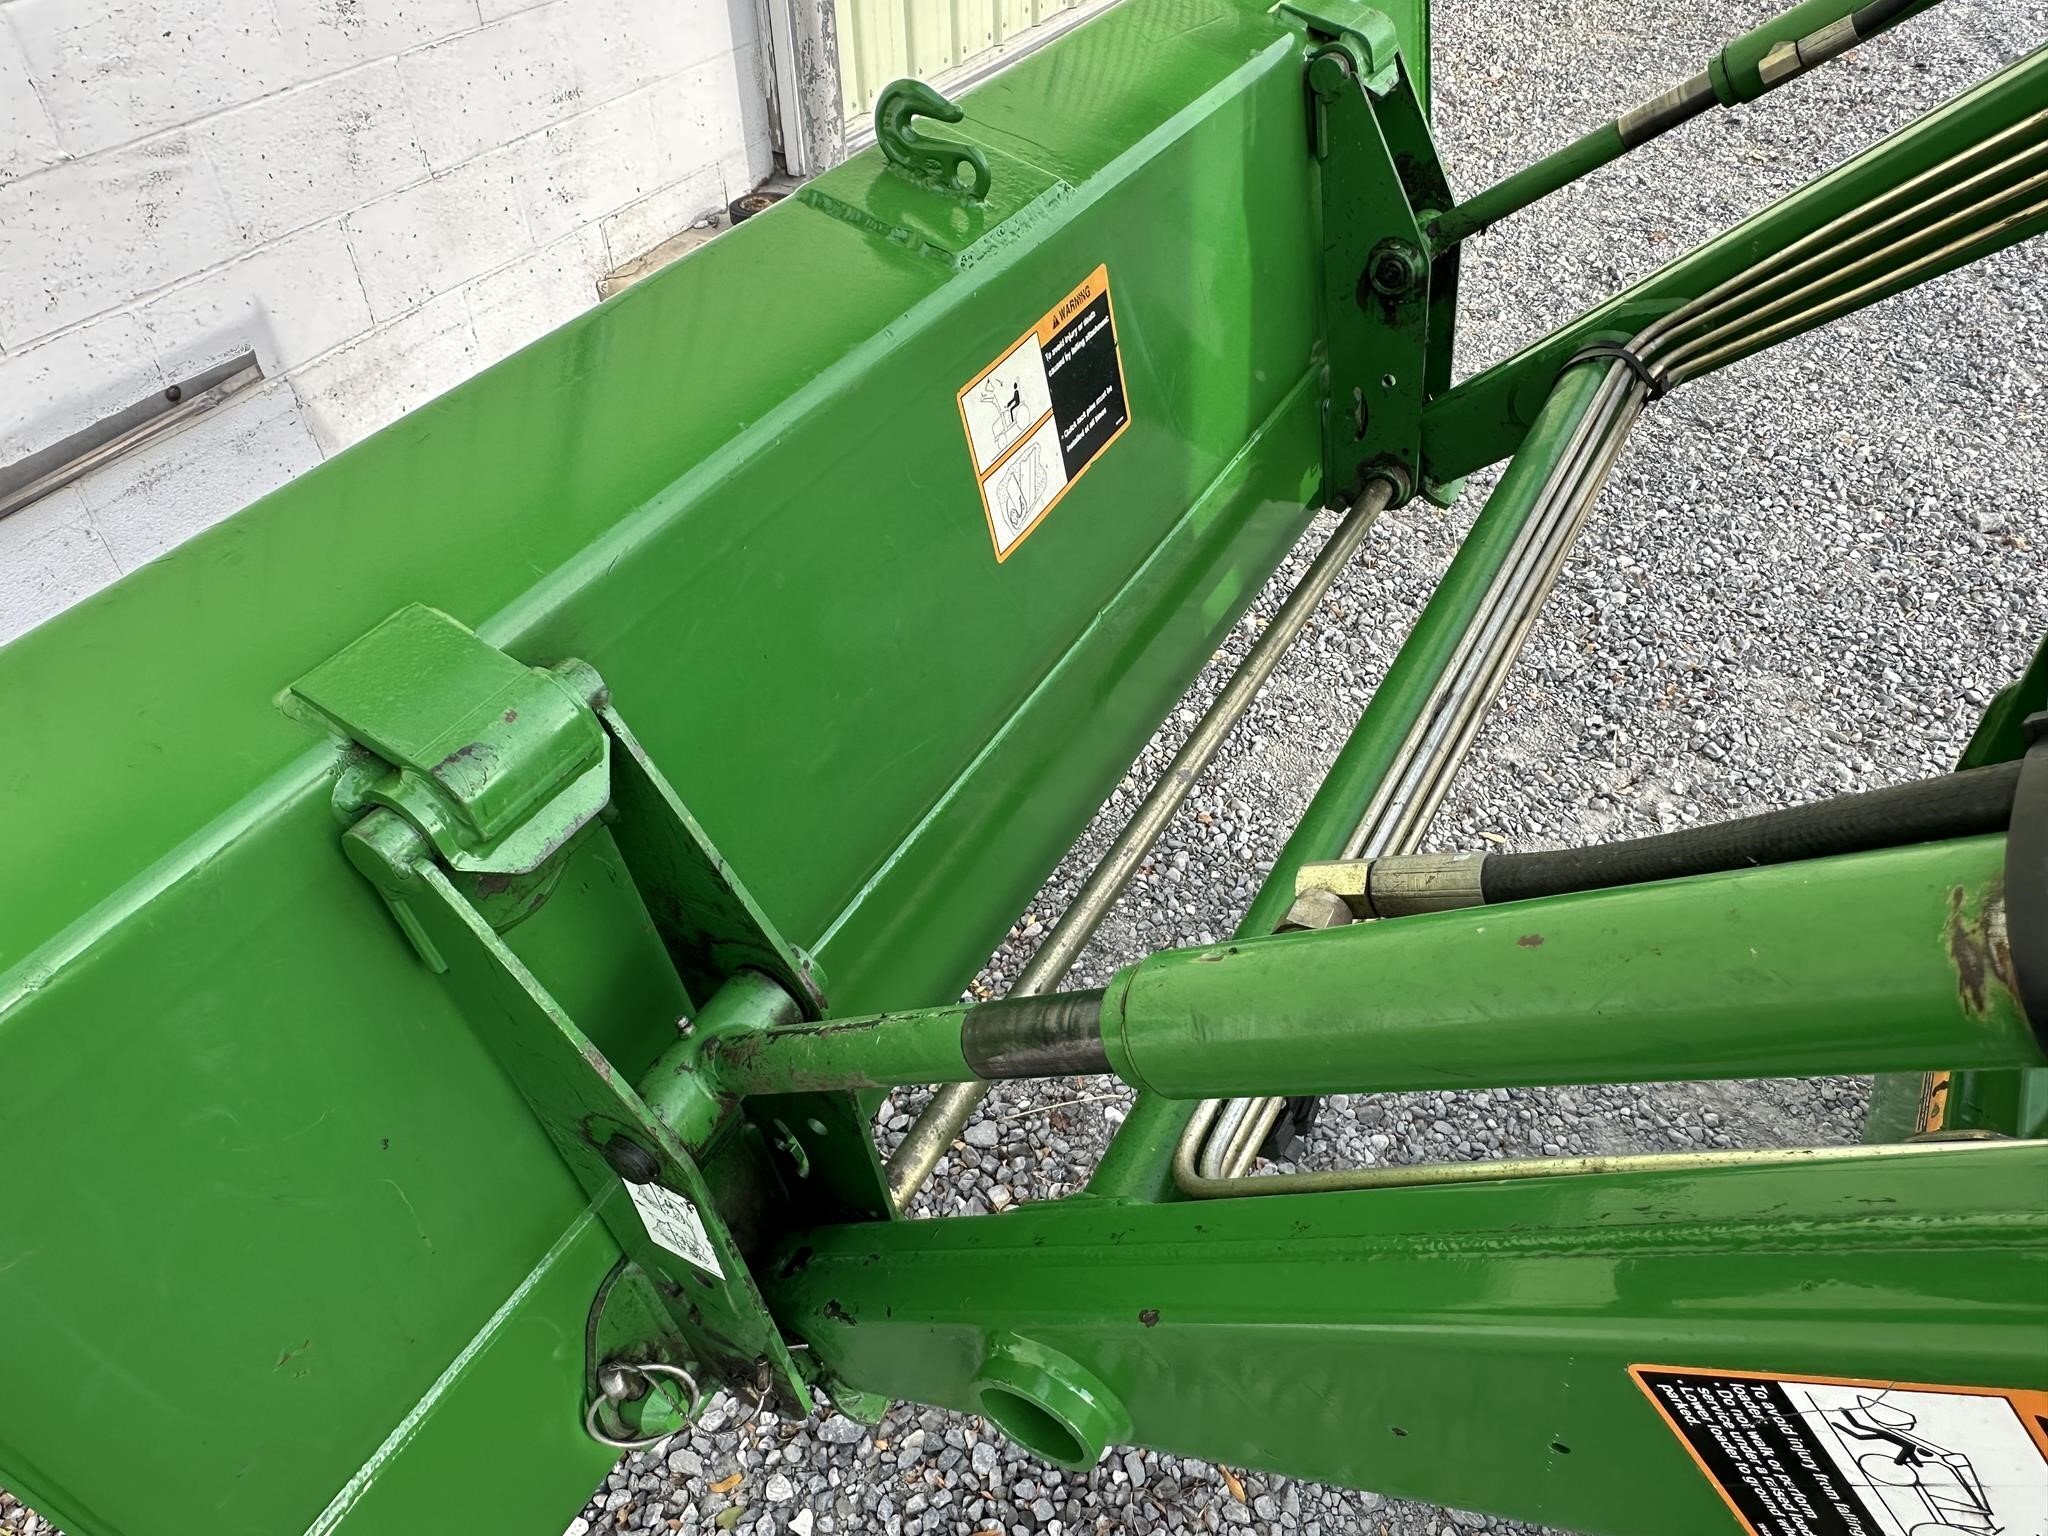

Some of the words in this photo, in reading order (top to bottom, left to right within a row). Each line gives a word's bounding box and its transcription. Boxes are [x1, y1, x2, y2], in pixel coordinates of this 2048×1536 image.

[1059, 285, 1091, 321] WARNING
[1656, 1384, 1701, 1426] parked.
[1680, 1387, 1714, 1422] Lower
[1716, 1389, 1736, 1406] Do
[1730, 1409, 1756, 1429] not
[1707, 1424, 1742, 1460] loader
[1747, 1431, 1775, 1457] walk
[1750, 1385, 1769, 1400] To
[1761, 1402, 1798, 1435] avoid
[1787, 1438, 1820, 1471] injury
[1813, 1473, 1840, 1500] from
[1697, 1386, 1735, 1429] service
[1729, 1431, 1762, 1465] under
[1755, 1466, 1768, 1474] a
[1762, 1476, 1799, 1511] raised
[1788, 1513, 1818, 1536] load
[1735, 1462, 1750, 1474] to
[1767, 1459, 1785, 1472] or
[1742, 1476, 1786, 1517] ground
[1773, 1473, 1818, 1519] perform
